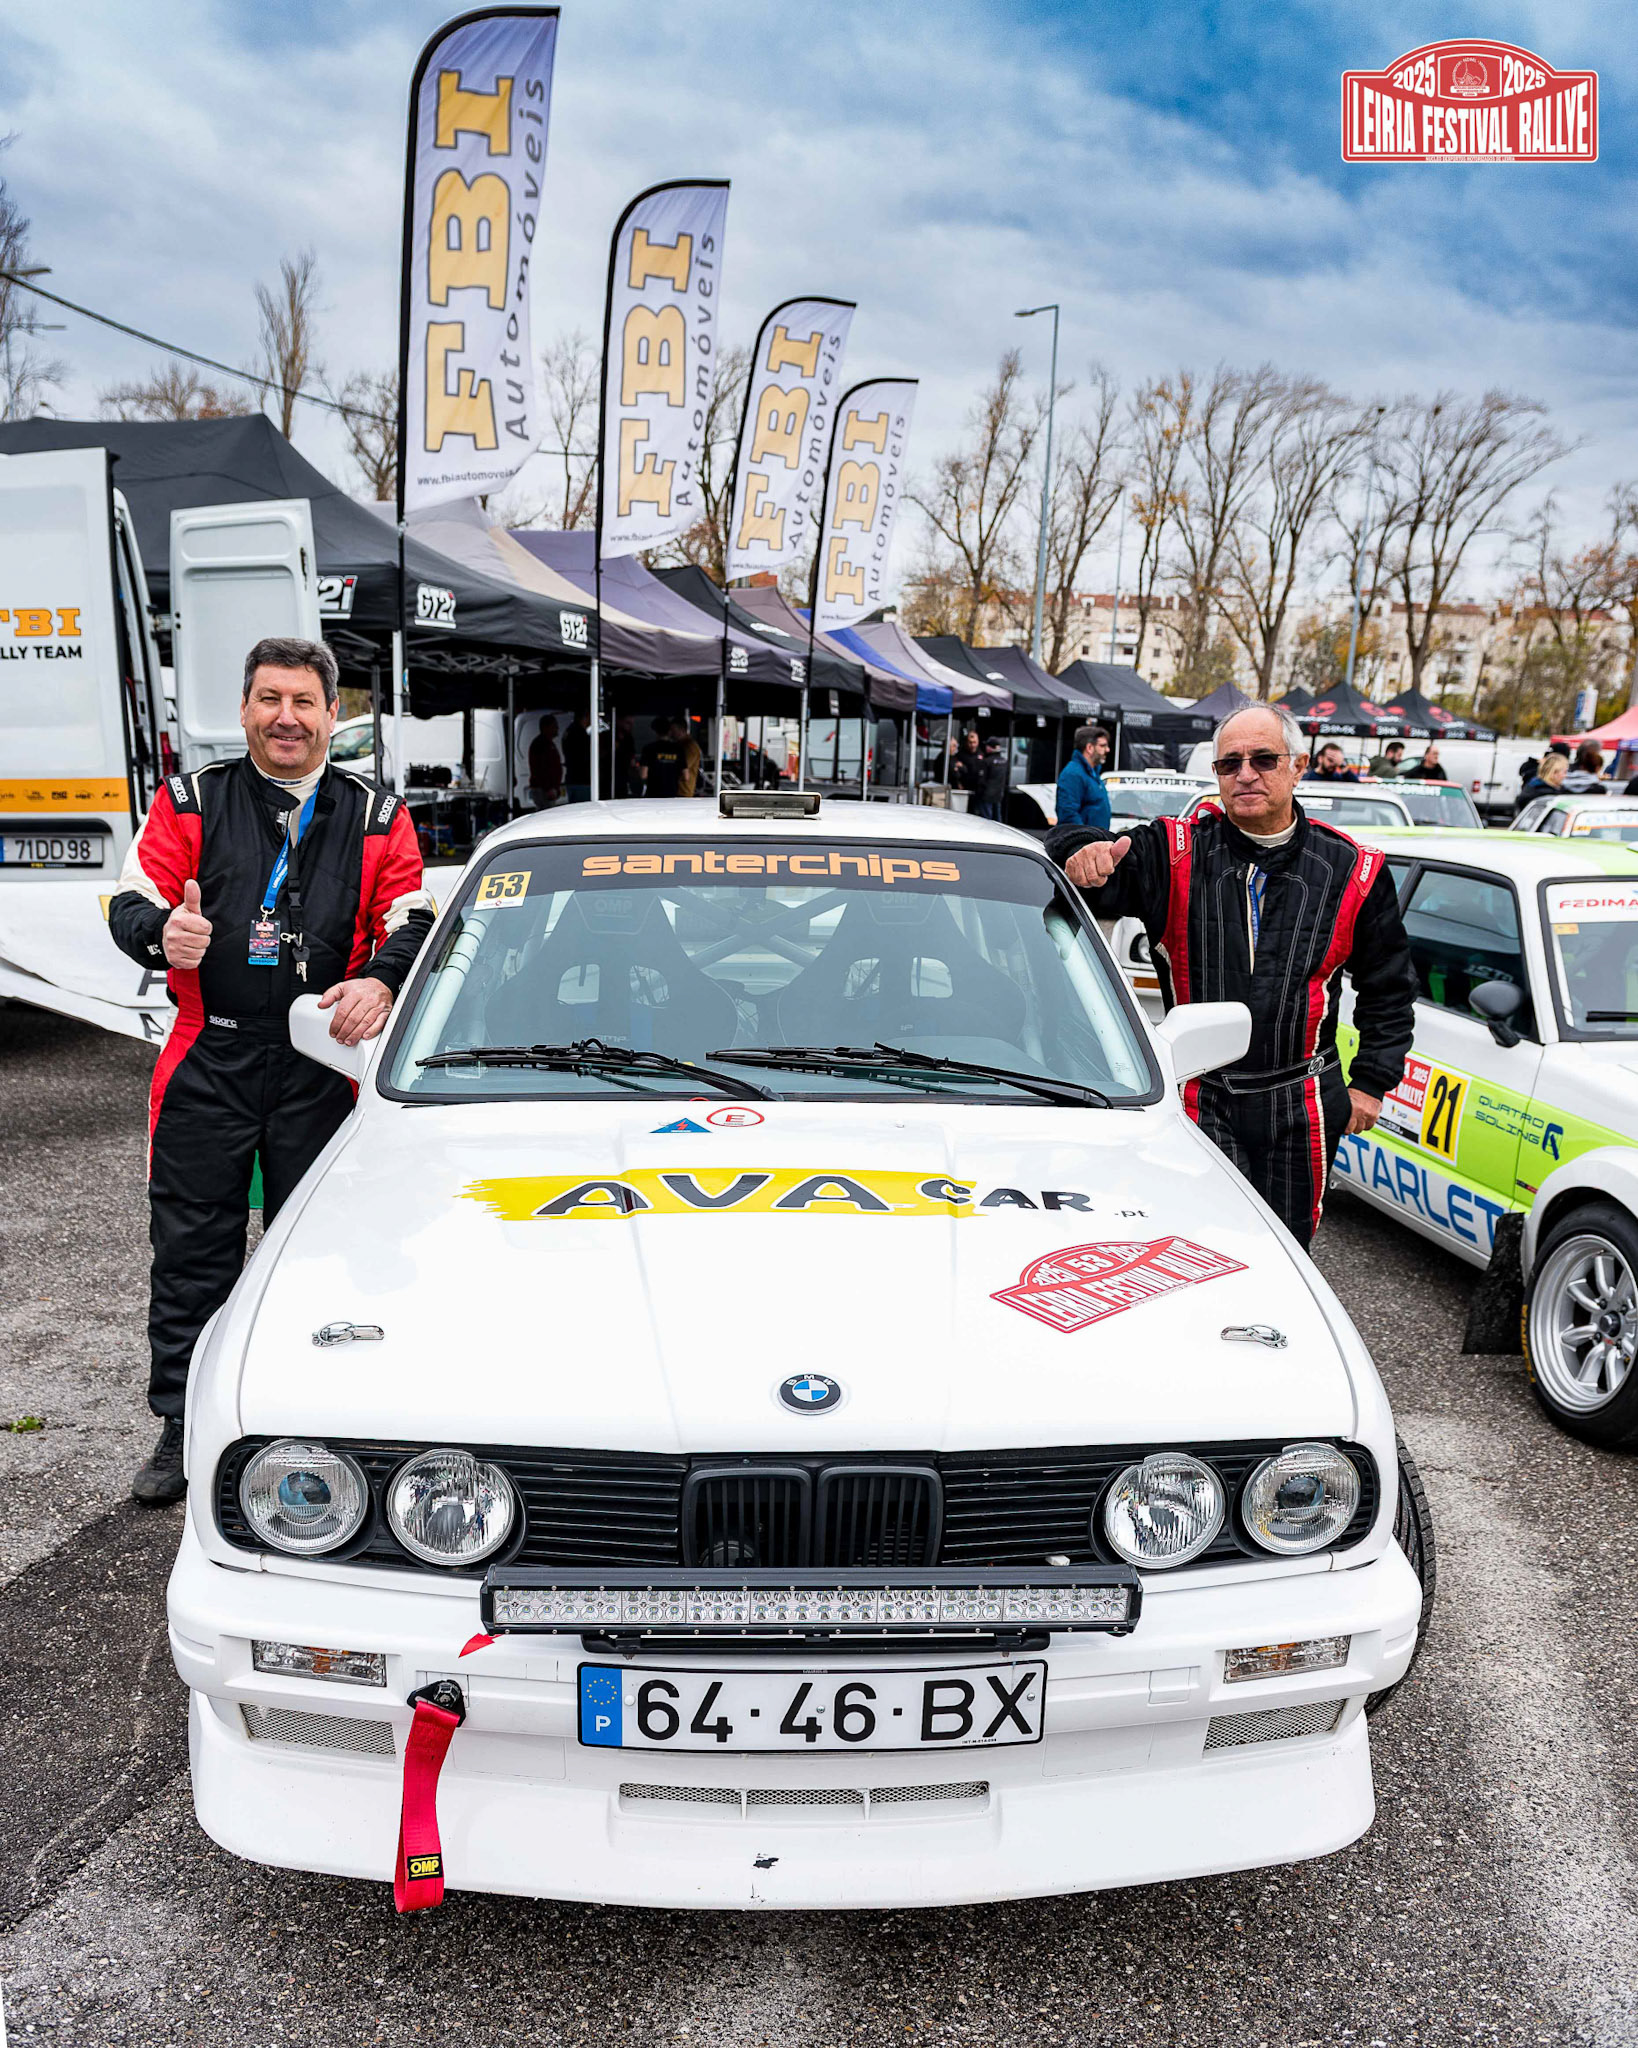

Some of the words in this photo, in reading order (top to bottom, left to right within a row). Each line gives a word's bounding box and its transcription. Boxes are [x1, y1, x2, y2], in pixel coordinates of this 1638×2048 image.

[424, 68, 516, 452] FBI
[506, 77, 546, 442] Automóveis
[617, 227, 694, 518] FBI
[676, 234, 716, 507] Automóveis
[736, 324, 824, 552] FBI
[788, 335, 841, 549] Automóveis
[825, 409, 890, 606] FBI
[868, 417, 905, 602] Automóveis
[0, 646, 27, 660] LLY
[33, 645, 82, 660] TEAM
[485, 874, 525, 899] 53
[582, 851, 961, 884] santerchips
[209, 1015, 238, 1027] sparc
[1411, 1065, 1429, 1084] 2025
[1396, 1081, 1425, 1108] RALLYE
[1478, 1094, 1546, 1129] QUATRO
[725, 1114, 746, 1123] E
[1426, 1075, 1462, 1154] 21
[1474, 1110, 1541, 1146] SOLING
[1332, 1132, 1505, 1250] STARLET
[1002, 1286, 1117, 1326] LEIRIA
[1079, 1264, 1188, 1306] FESTIVAL
[1149, 1239, 1242, 1282] RALLYE
[1032, 1261, 1083, 1287] 2025
[1063, 1253, 1115, 1274] 53
[1096, 1244, 1151, 1264] 2025
[785, 1374, 835, 1386] BMW
[594, 1714, 612, 1732] P
[410, 1858, 440, 1873] OMP
